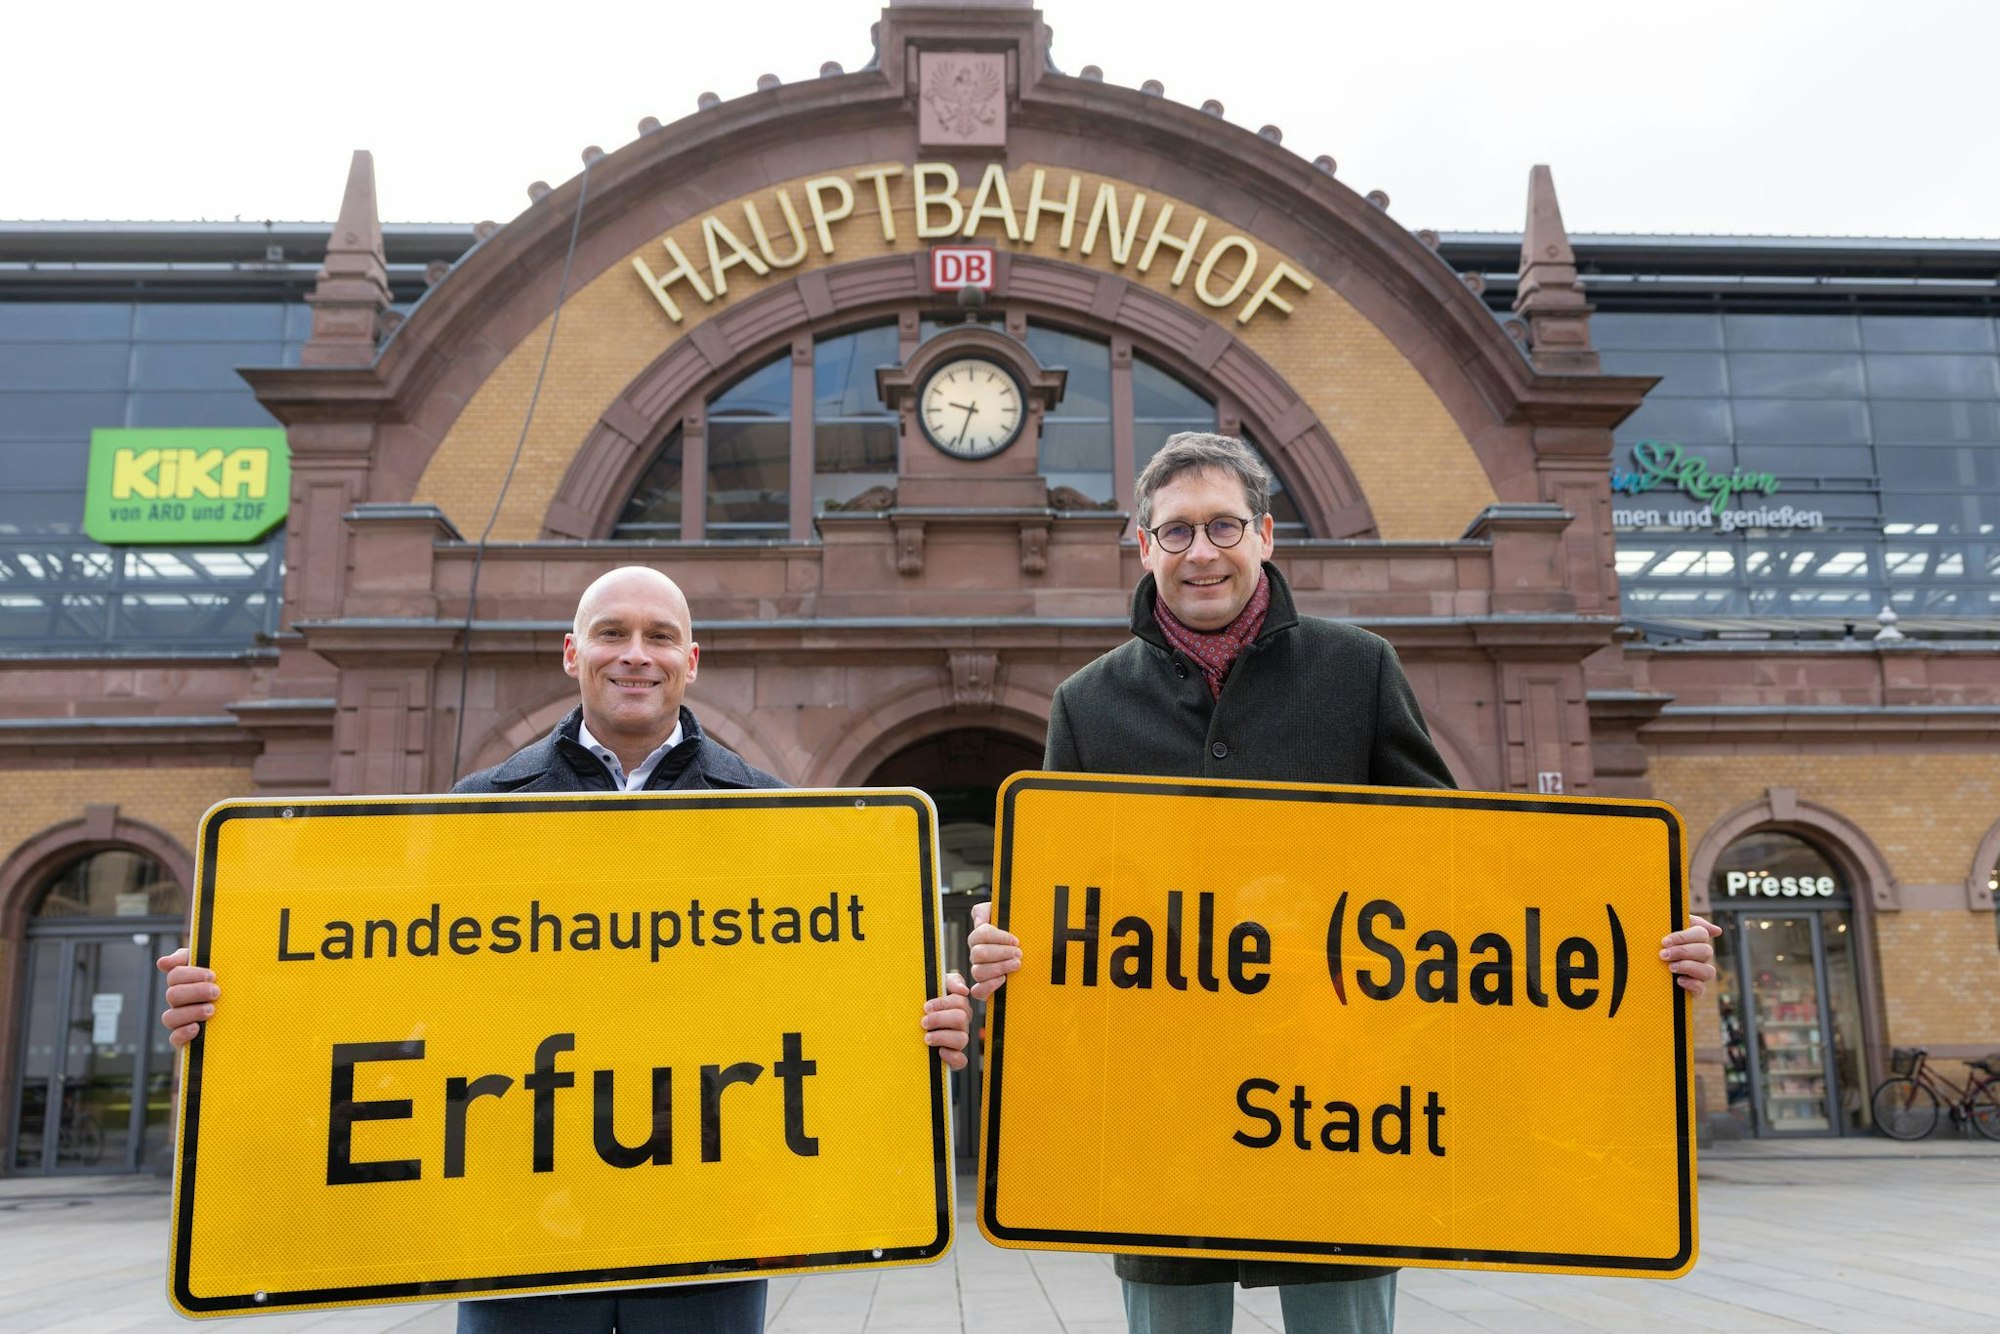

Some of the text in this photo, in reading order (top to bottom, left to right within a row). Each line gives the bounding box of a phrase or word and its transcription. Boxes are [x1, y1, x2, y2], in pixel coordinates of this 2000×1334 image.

[631, 162, 1313, 324] HAUPTBAHNHOF
[942, 255, 987, 283] DB
[110, 502, 266, 521] von ARD und ZDF
[1677, 456, 1780, 515] Region
[1612, 505, 1824, 532] men und genießen
[1542, 775, 1560, 793] 12
[1727, 871, 1835, 897] Presse
[278, 892, 866, 963] Landeshauptstadt
[1050, 886, 1629, 1018] Halle (Saale)
[326, 1032, 820, 1186] Erfurt
[1233, 1078, 1447, 1158] Stadt
